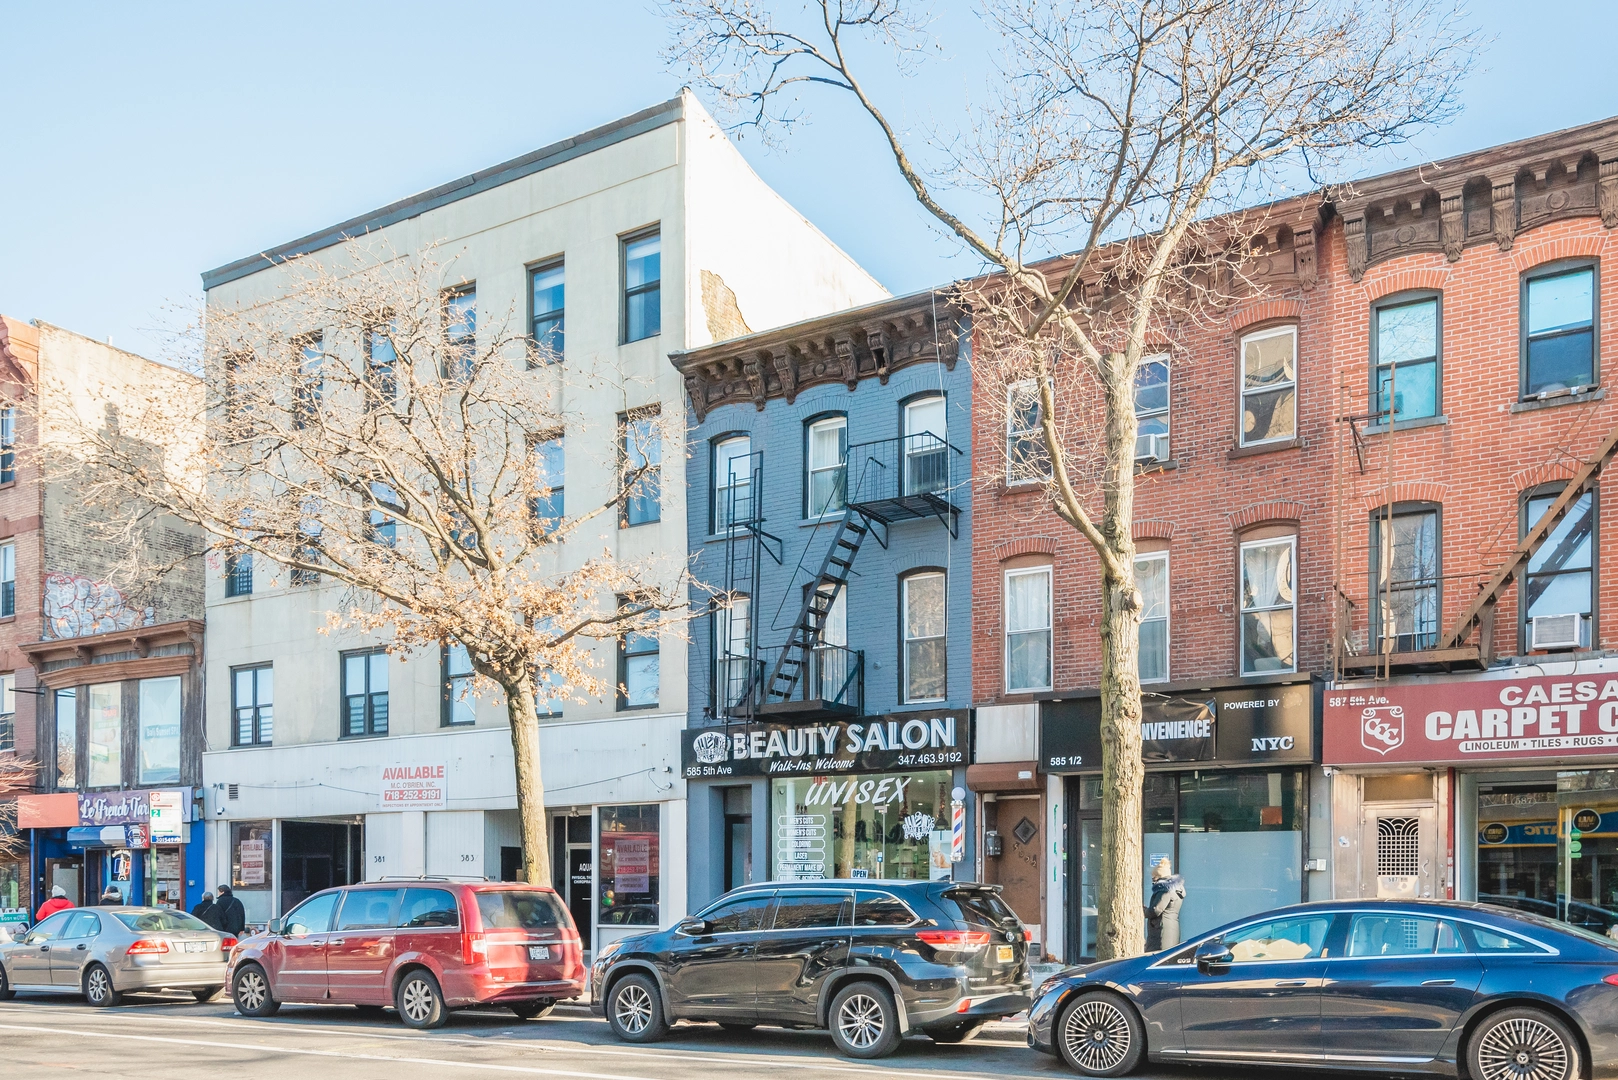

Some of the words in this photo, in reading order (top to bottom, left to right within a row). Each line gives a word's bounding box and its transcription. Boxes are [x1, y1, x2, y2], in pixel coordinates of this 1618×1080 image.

[1500, 680, 1618, 706] CAESA
[1224, 700, 1265, 710] POWERED
[1268, 699, 1280, 707] BY
[1329, 697, 1347, 707] 587
[1349, 696, 1365, 706] 5th
[1368, 695, 1389, 705] Ave.
[1425, 704, 1588, 741] CARPET
[1141, 719, 1211, 741] NVENIENCE
[733, 725, 839, 760] BEAUTY
[846, 717, 956, 754] SALON
[1251, 736, 1295, 752] NYC
[1464, 740, 1520, 751] LINOLEUM
[1530, 738, 1562, 748] TILES
[1573, 736, 1604, 746] RUGS
[769, 759, 811, 773] Walk-Ins
[815, 757, 855, 770] Welcome
[898, 752, 962, 765] 347.463.9192
[1050, 757, 1067, 766] 585
[1068, 756, 1082, 765] 1/2
[382, 765, 445, 780] AVAILABLE
[686, 767, 701, 776] 585
[703, 766, 716, 776] 5th
[716, 766, 732, 775] Ave
[385, 789, 440, 800] 718-252-9191
[804, 776, 912, 807] UNISEX
[81, 798, 95, 819] Le
[95, 797, 129, 819] French
[130, 796, 149, 818] Tar
[803, 817, 814, 825] CUTS
[616, 844, 647, 853] AVAILABLE
[794, 852, 808, 860] LASER
[852, 869, 867, 878] OPEN
